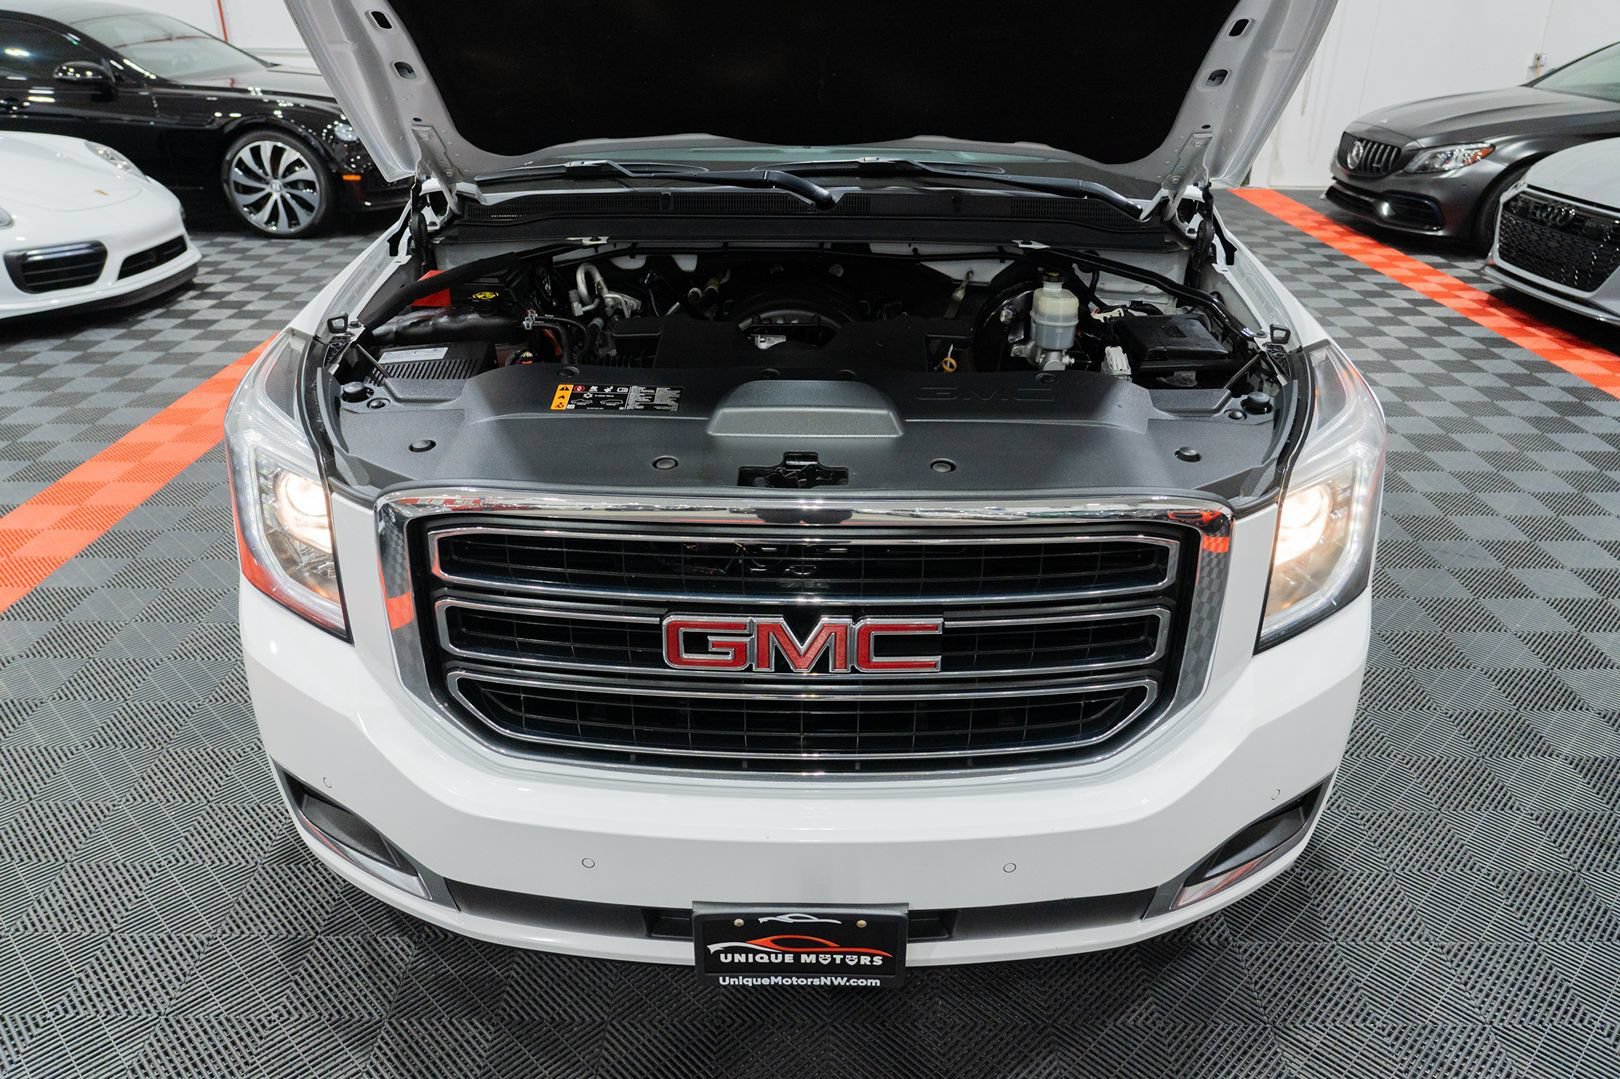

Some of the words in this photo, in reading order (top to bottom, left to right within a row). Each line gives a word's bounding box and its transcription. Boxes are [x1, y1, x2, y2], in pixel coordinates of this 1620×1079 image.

[913, 385, 1055, 402] GMC
[662, 614, 944, 673] GMC
[720, 953, 794, 963] UNIQUE
[800, 954, 883, 965] MOTORS
[719, 976, 880, 986] UniqueMotorsNW.com
